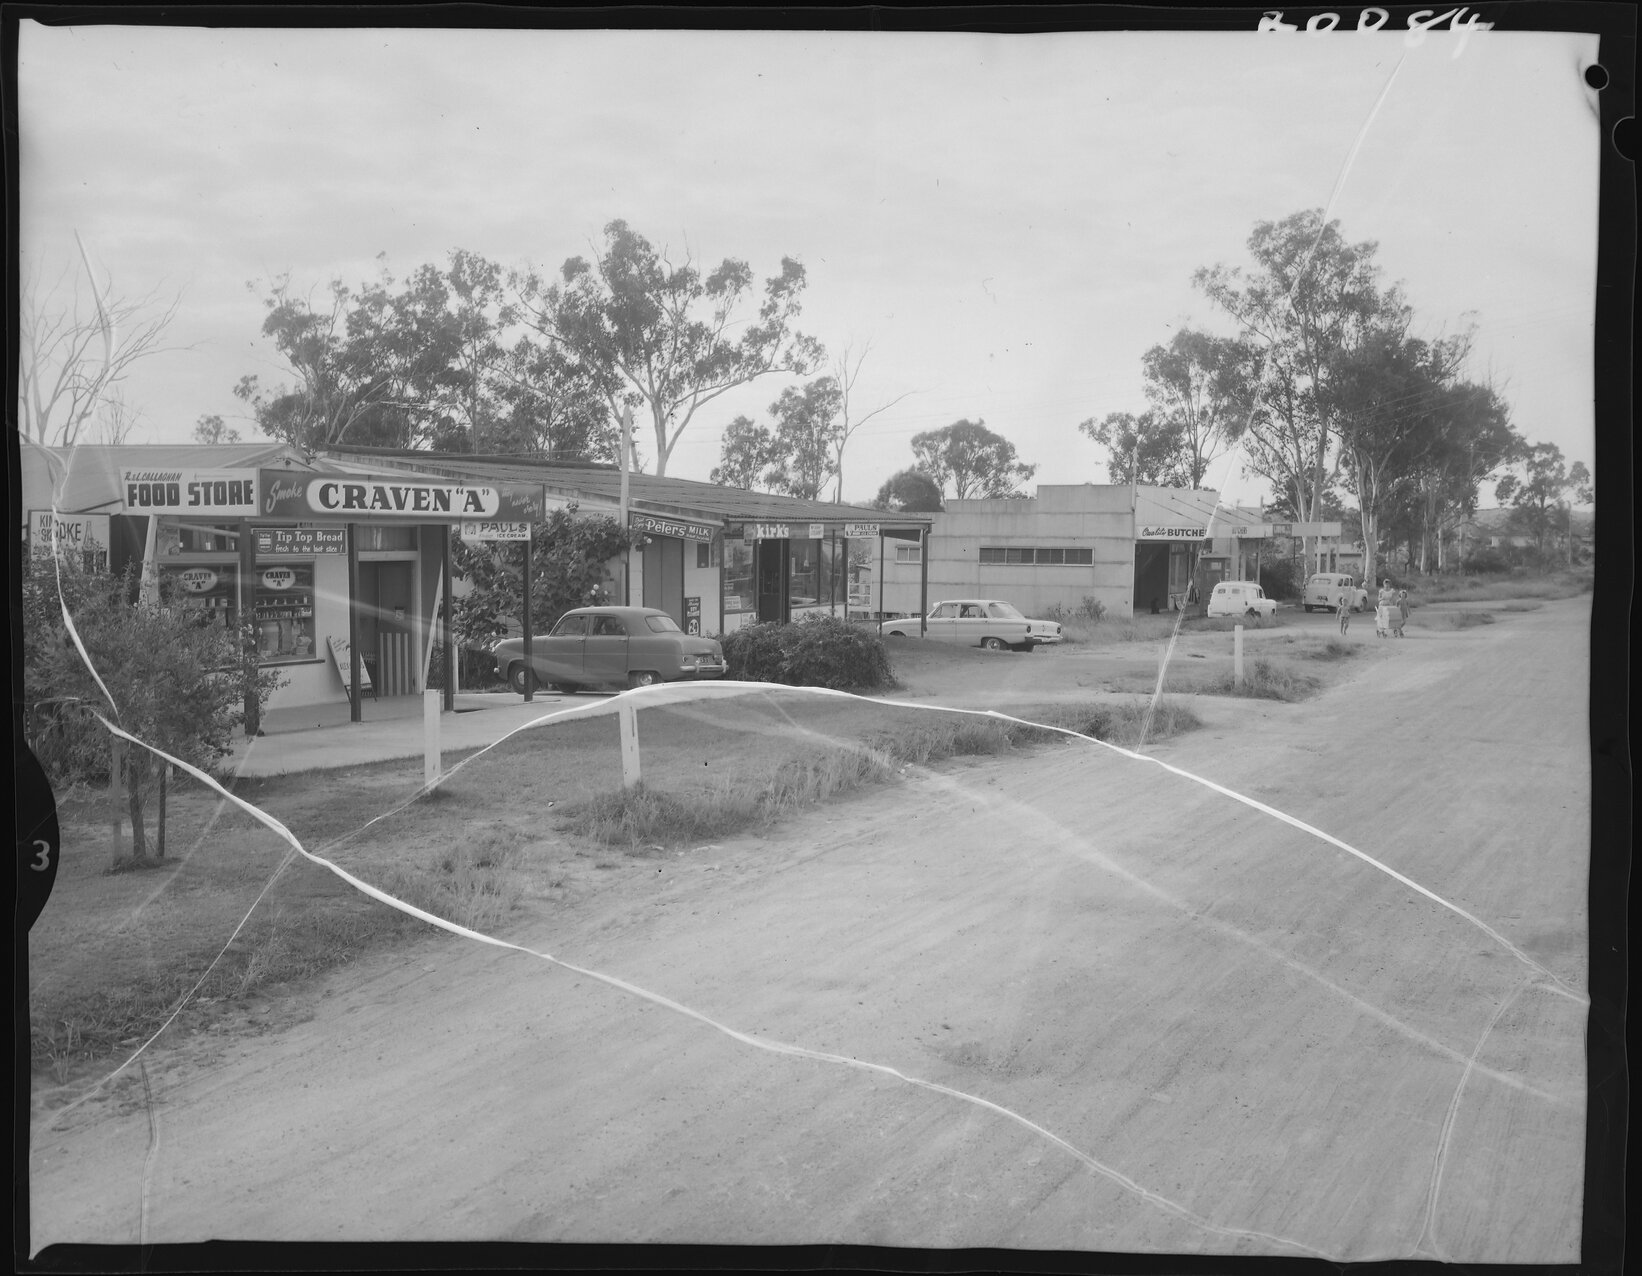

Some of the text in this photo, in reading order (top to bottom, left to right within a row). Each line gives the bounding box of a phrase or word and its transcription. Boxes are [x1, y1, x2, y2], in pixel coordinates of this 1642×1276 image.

[127, 480, 254, 507] FOOD STORE
[265, 480, 303, 513] Smoke
[319, 483, 451, 512] CRAVEN
[479, 522, 528, 533] PAULS
[688, 526, 709, 536] MILK
[1167, 528, 1207, 537] BUTCHE
[275, 530, 343, 544] Tip Top Bread
[30, 839, 50, 872] 3
